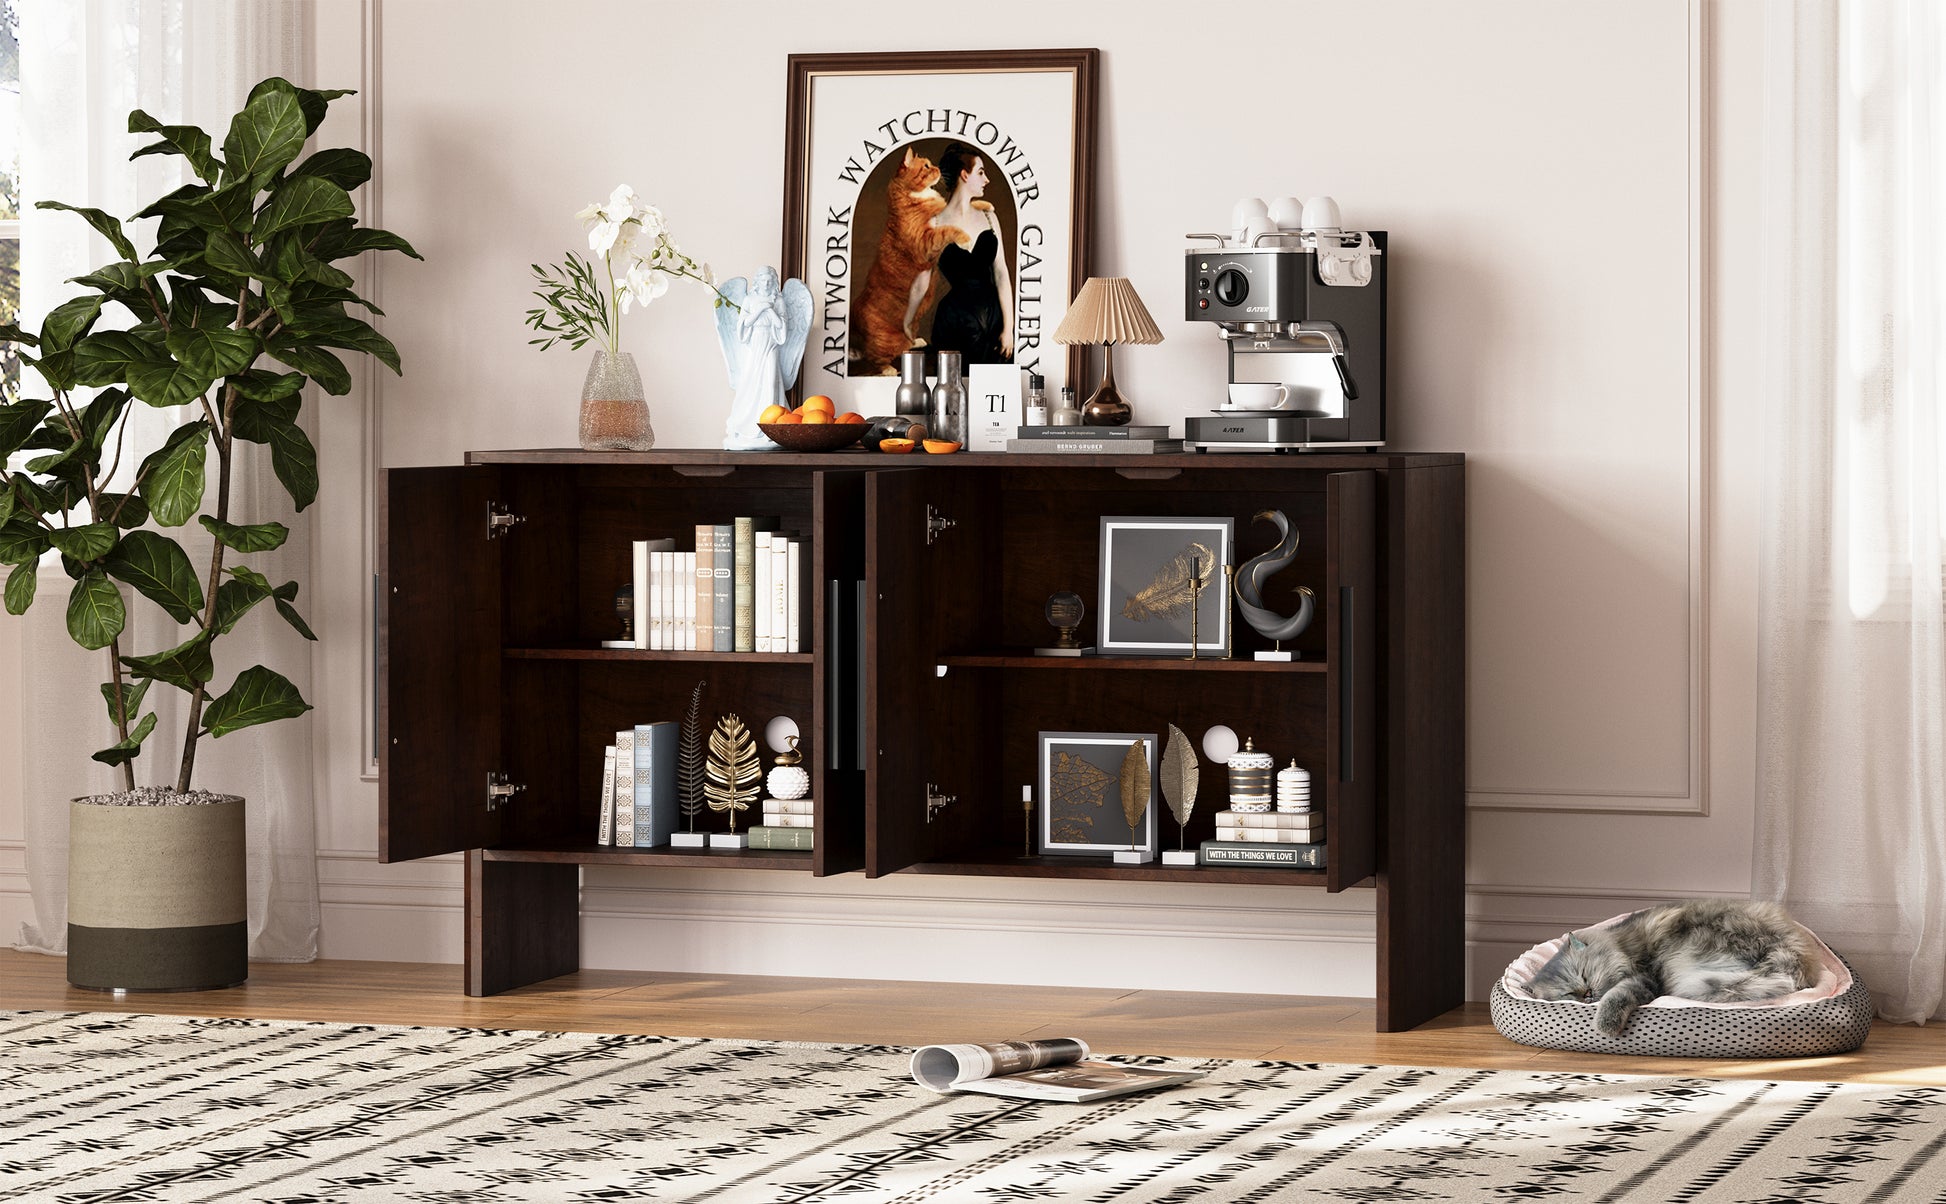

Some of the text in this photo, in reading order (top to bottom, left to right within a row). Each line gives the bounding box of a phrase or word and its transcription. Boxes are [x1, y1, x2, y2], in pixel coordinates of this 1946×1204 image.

[823, 109, 1044, 379] ARTWORK WATCHTOWER GALLERY
[985, 394, 1006, 413] T1
[1209, 850, 1293, 861] WITH THE THINGS WE LOVE
